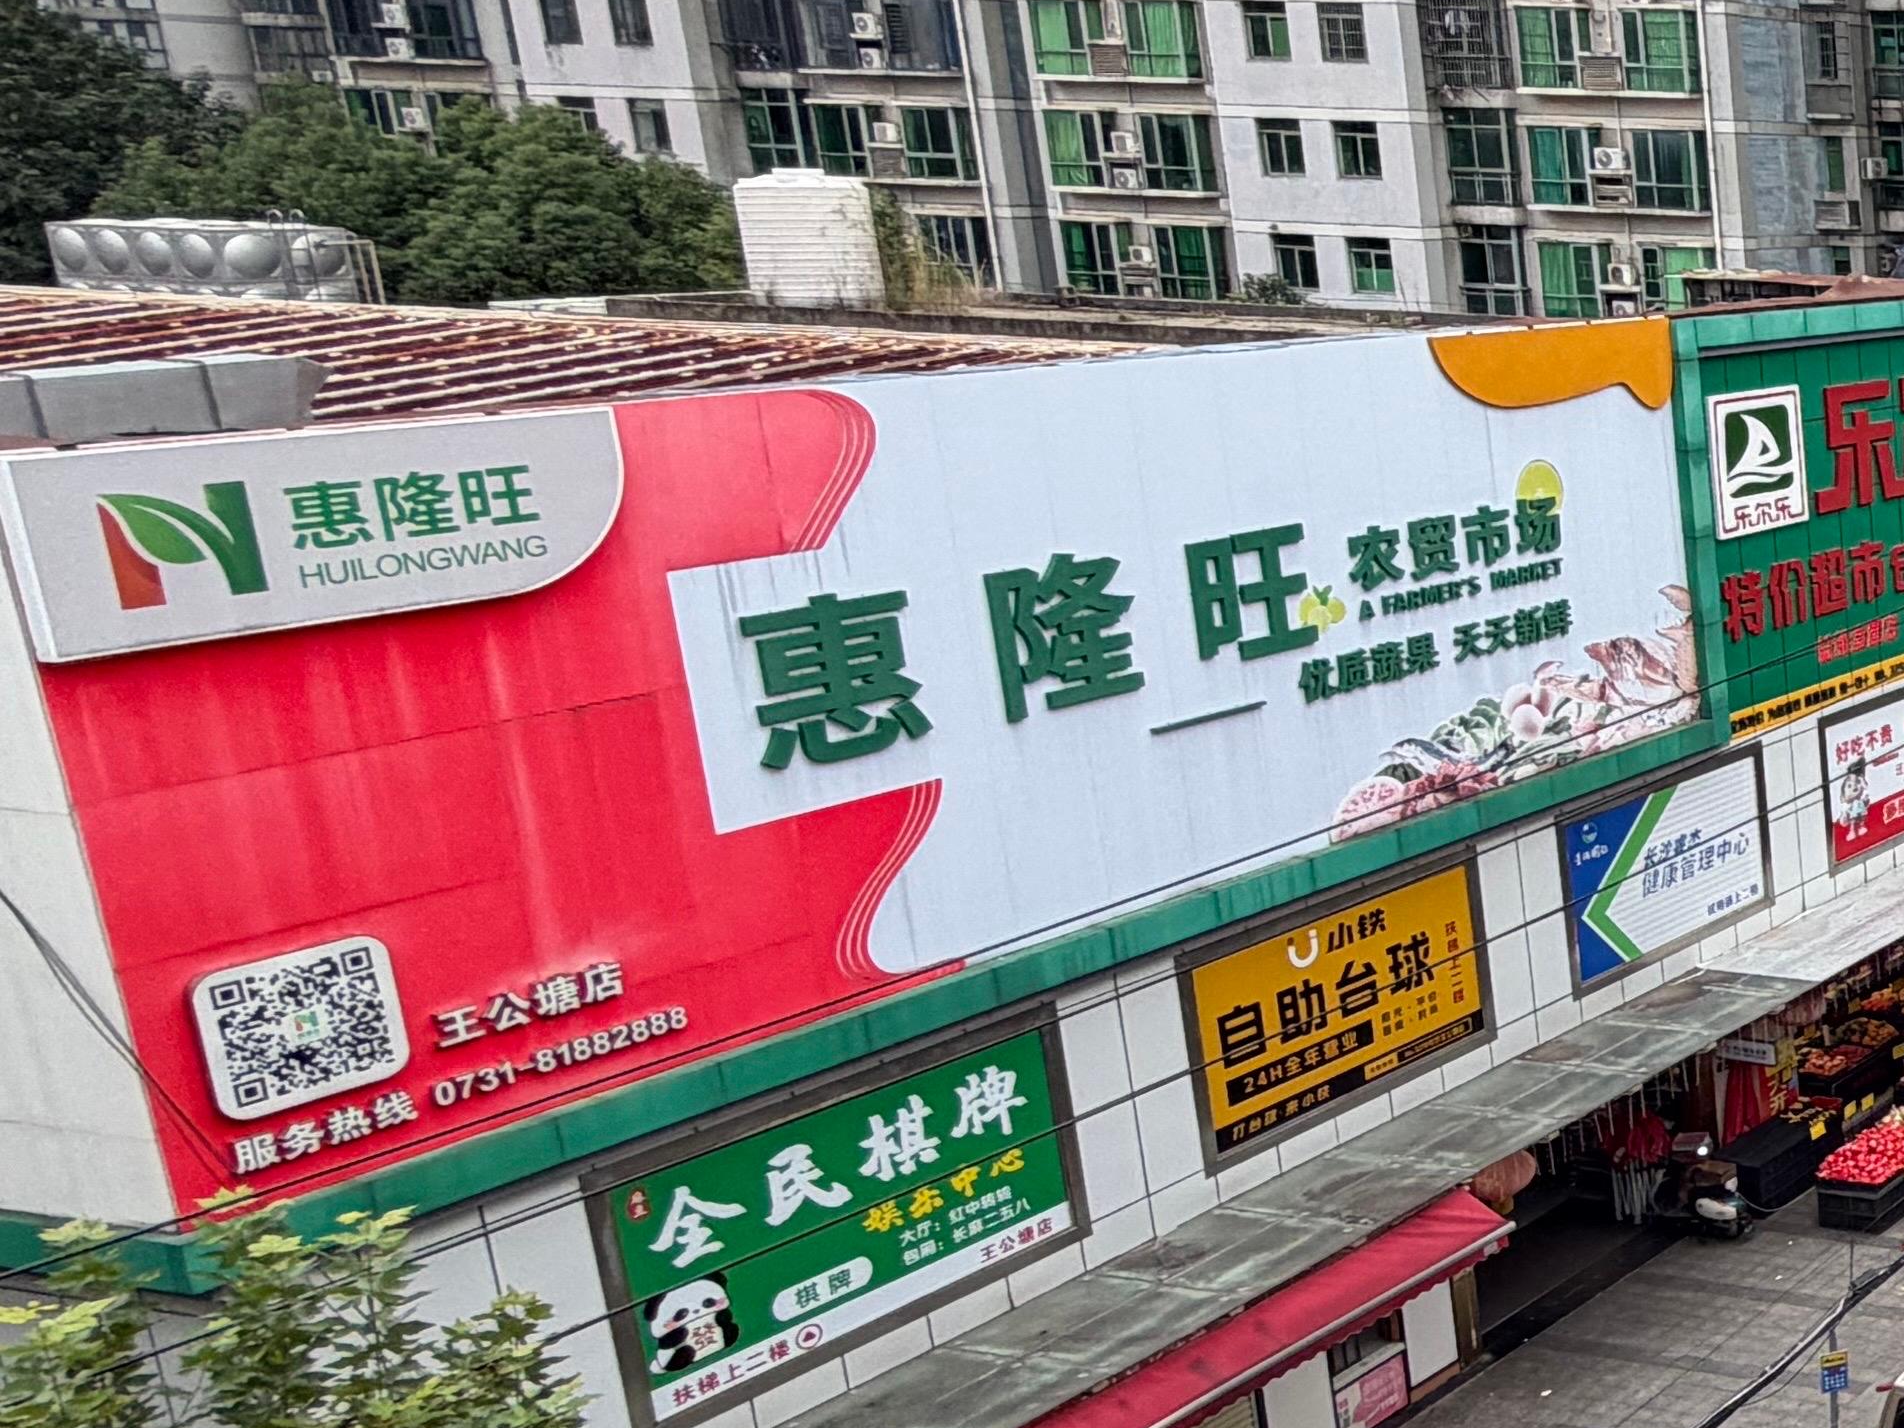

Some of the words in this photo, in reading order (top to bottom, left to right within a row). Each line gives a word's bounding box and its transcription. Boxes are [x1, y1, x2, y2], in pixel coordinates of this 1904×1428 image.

[283, 464, 541, 550] 惠隆旺
[1348, 497, 1562, 590] 农贸市场
[299, 536, 547, 589] HUILONGWANG
[1359, 600, 1374, 621] A
[1490, 558, 1562, 590] MARKET
[739, 523, 1321, 770] 惠隆旺
[1299, 632, 1440, 704] 优质蔬果
[1454, 599, 1573, 662] 天天新鲜
[1642, 832, 1749, 898] 健康管理中心
[1327, 908, 1386, 954] 小铁
[435, 962, 622, 1048] 王公塘店
[1217, 931, 1434, 1069] 自助台球
[234, 1091, 418, 1175] 服务热线
[434, 1007, 688, 1107] 0731-81882888
[1244, 1031, 1359, 1093] 24H全年营业
[649, 1065, 1027, 1268] 全民棋牌
[980, 1218, 1052, 1263] 王公塘店
[794, 1268, 852, 1308] 棋牌
[673, 1343, 790, 1408] 扶梯上二楼
